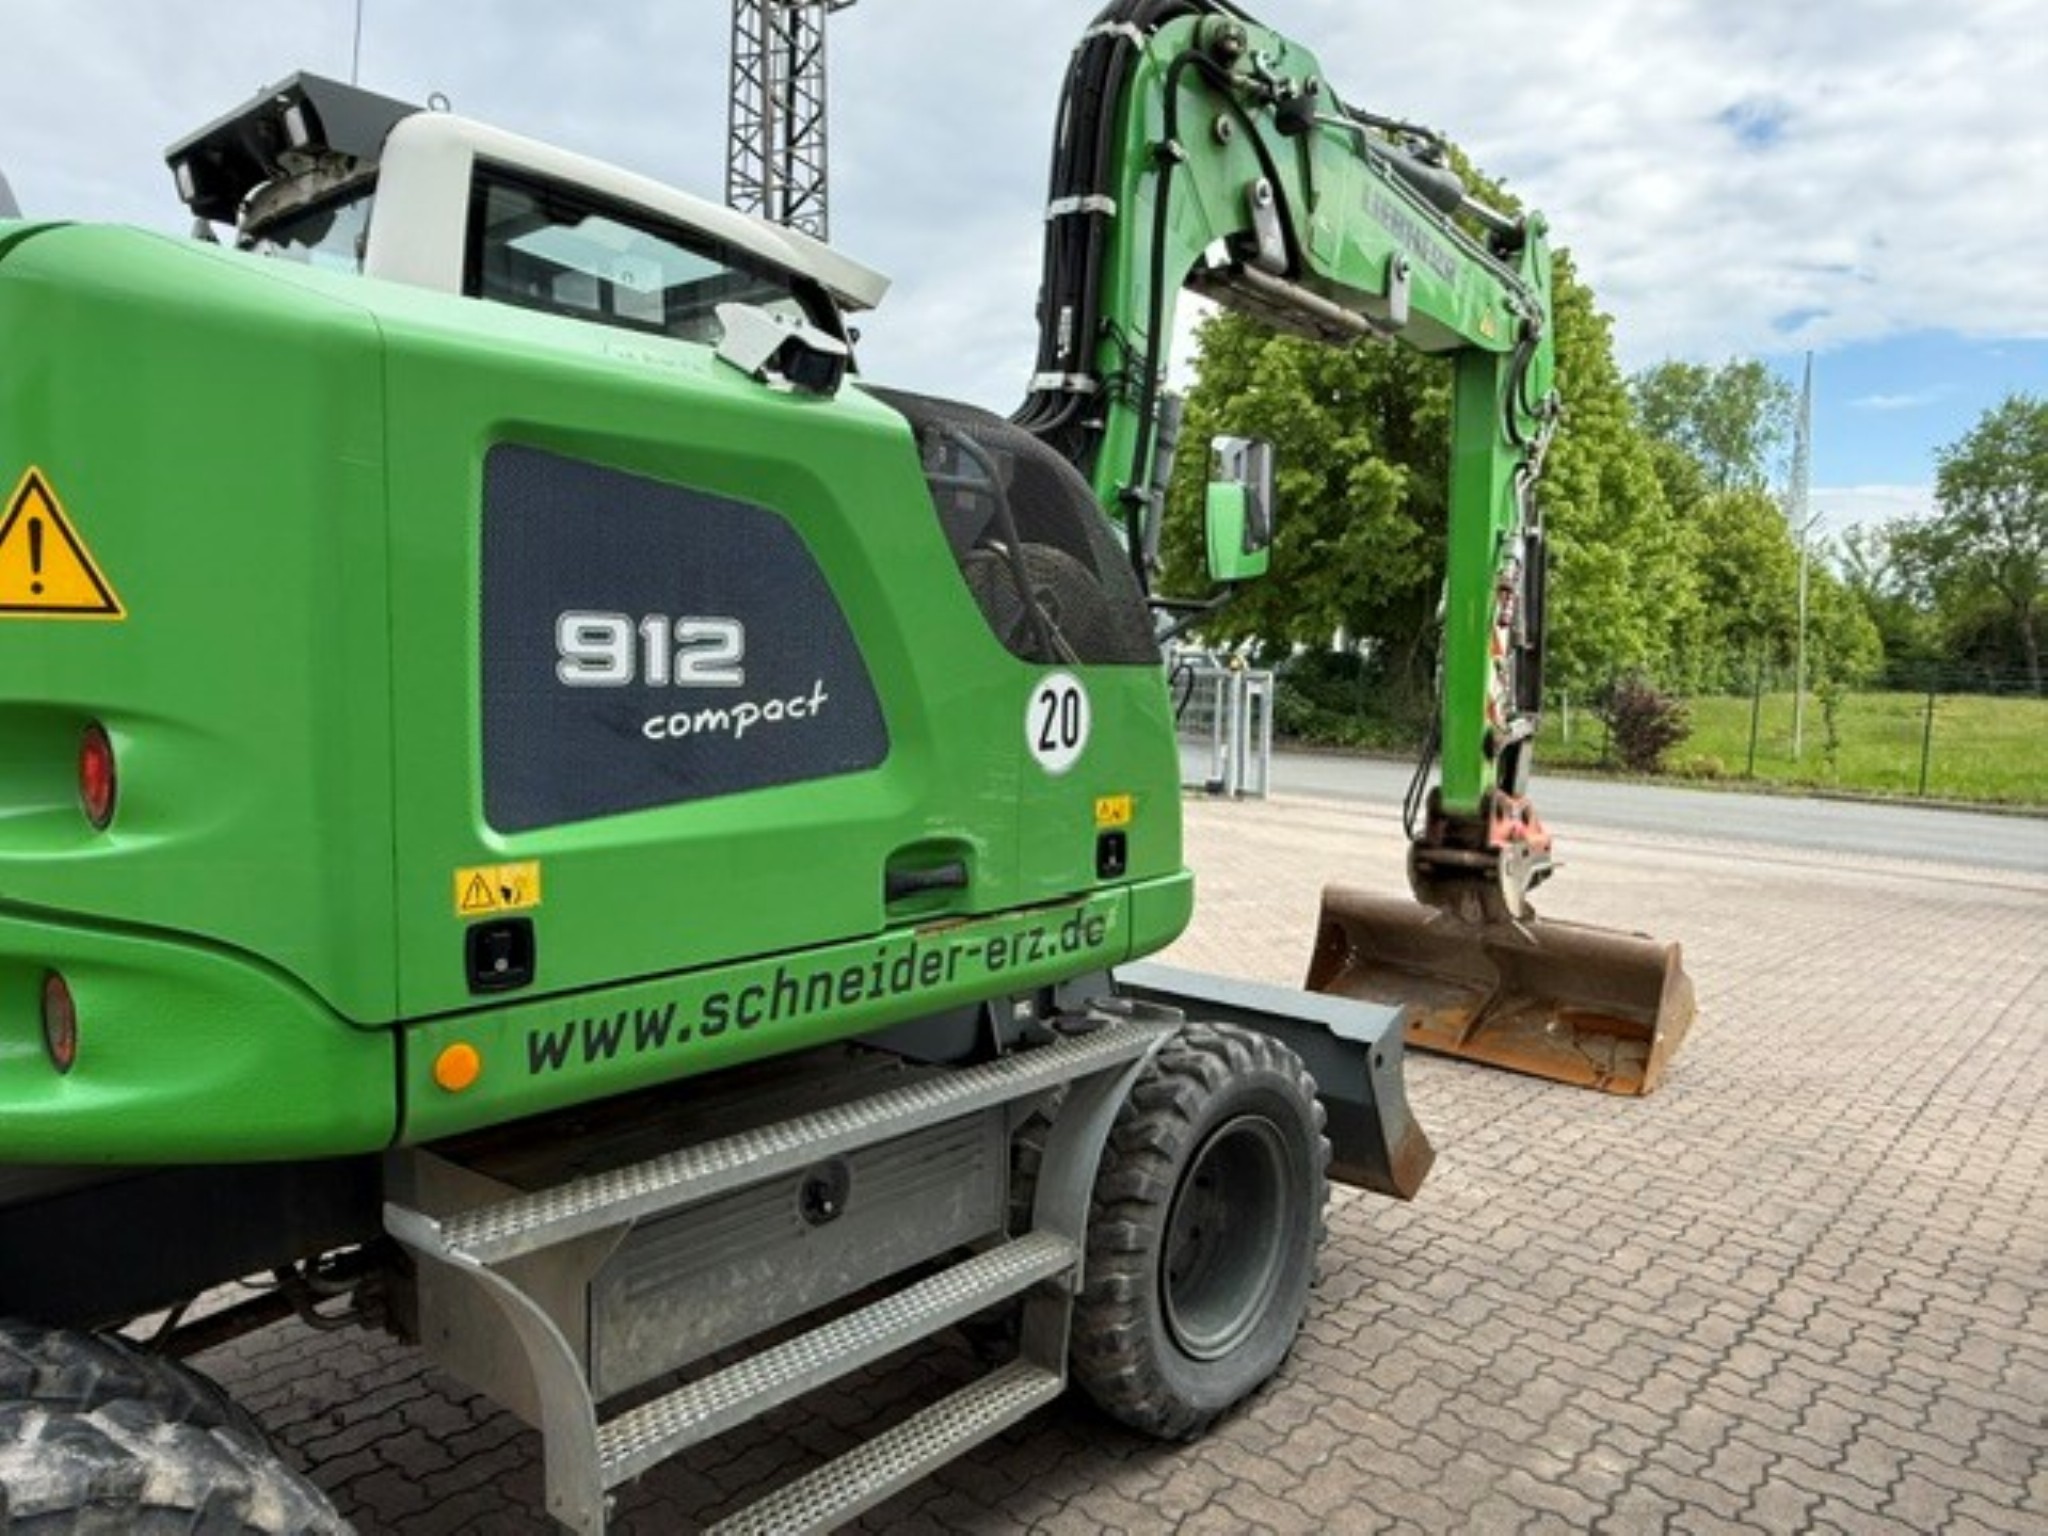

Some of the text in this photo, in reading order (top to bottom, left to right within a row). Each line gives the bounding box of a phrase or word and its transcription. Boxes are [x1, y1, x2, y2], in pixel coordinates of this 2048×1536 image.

[555, 611, 745, 687] 912
[642, 680, 829, 739] compact
[1039, 687, 1080, 751] 20
[527, 907, 1107, 1075] www.schneider-erz.de
